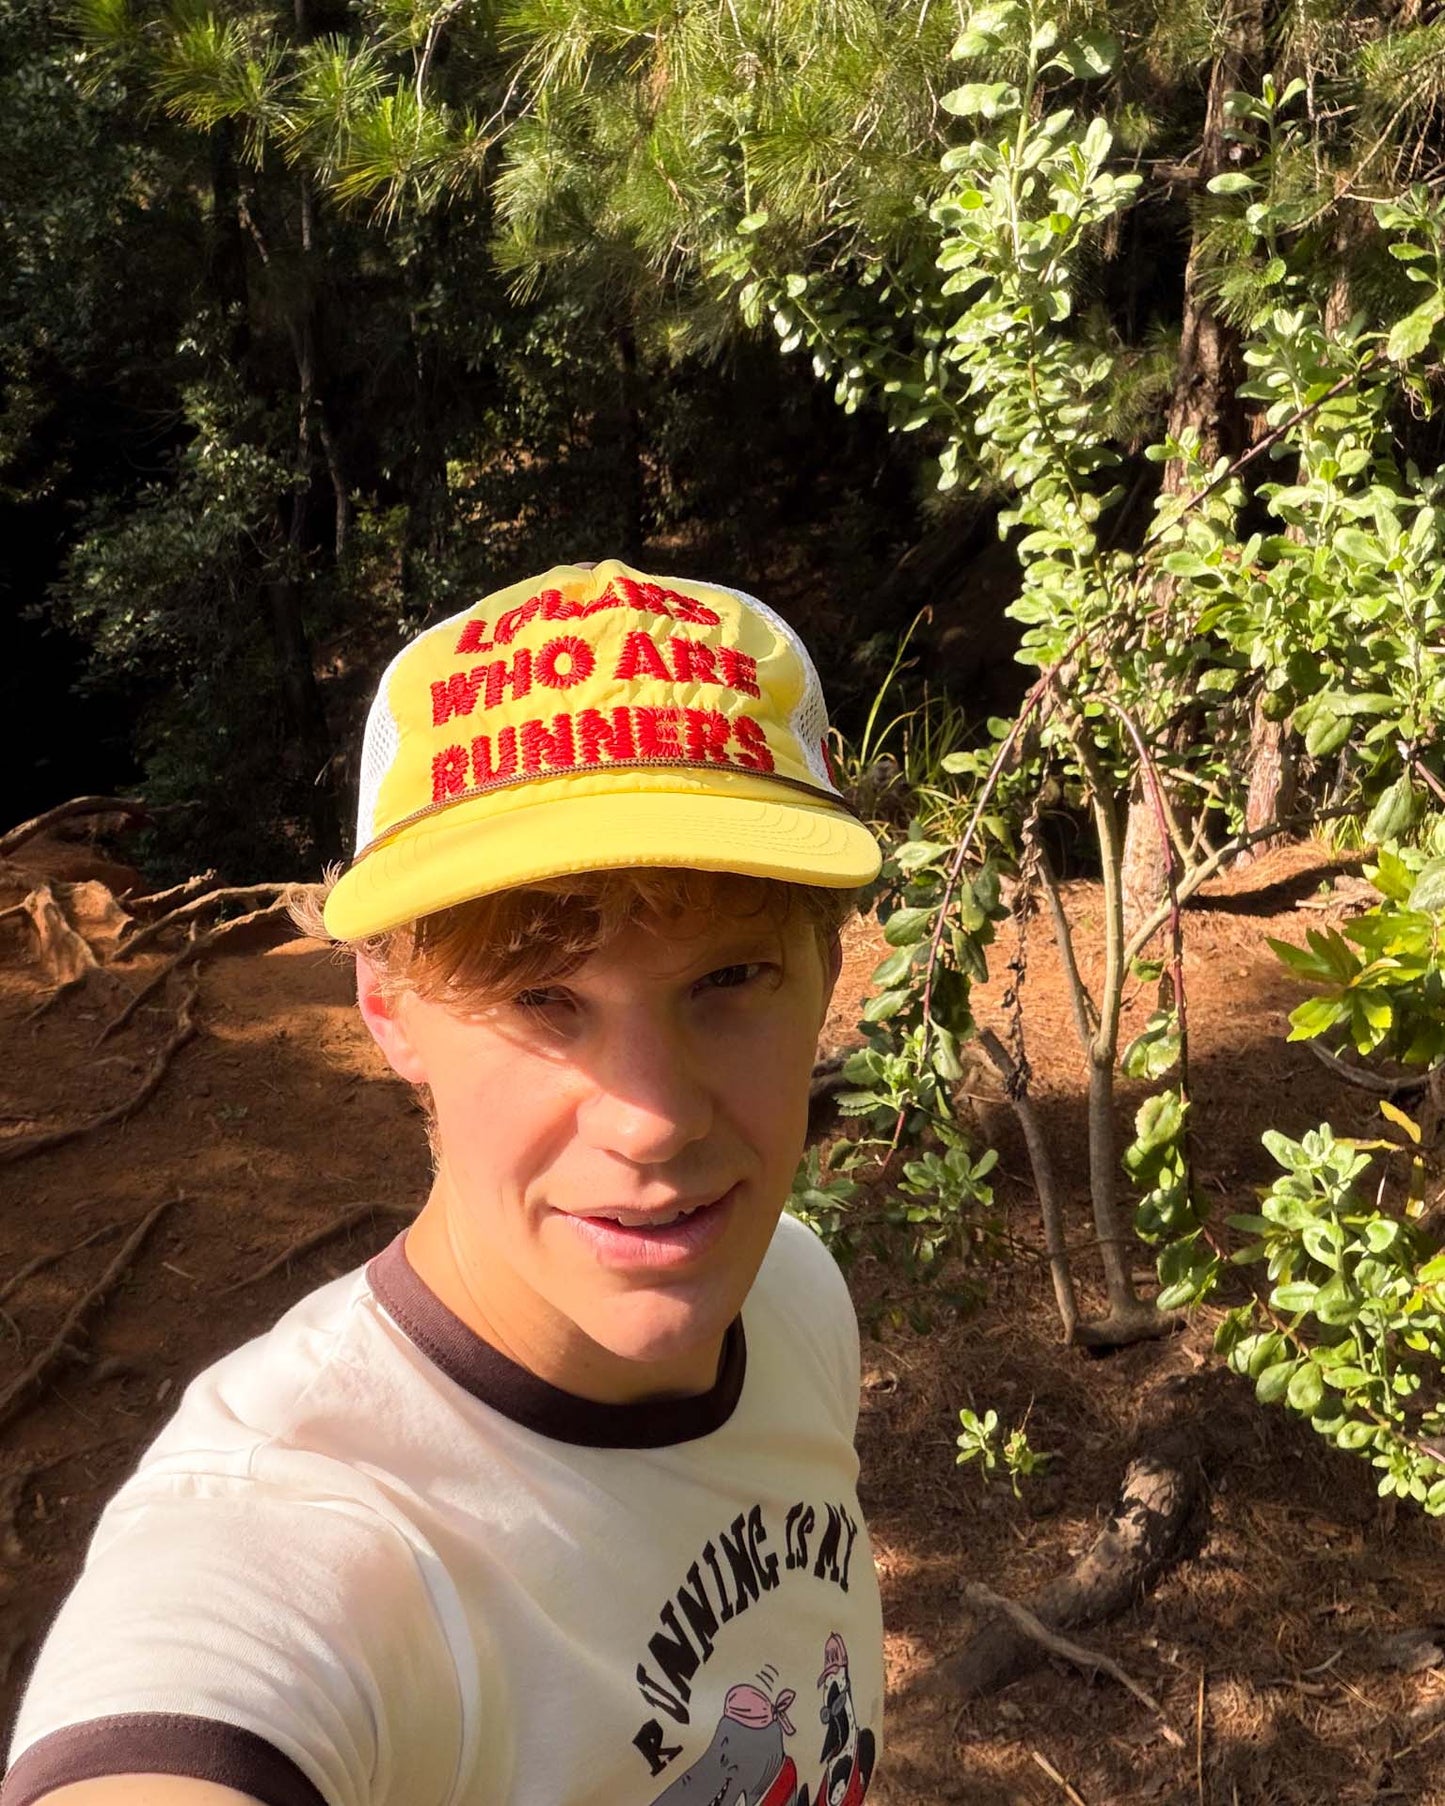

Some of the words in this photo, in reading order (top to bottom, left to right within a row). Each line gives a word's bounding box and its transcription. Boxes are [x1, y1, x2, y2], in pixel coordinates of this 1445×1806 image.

[430, 634, 596, 726] WHO
[613, 631, 761, 699] ARE
[430, 706, 775, 804] RUNNERS
[632, 1504, 780, 1777] RUNNING
[786, 1501, 815, 1570] IS
[813, 1501, 858, 1593] MY
